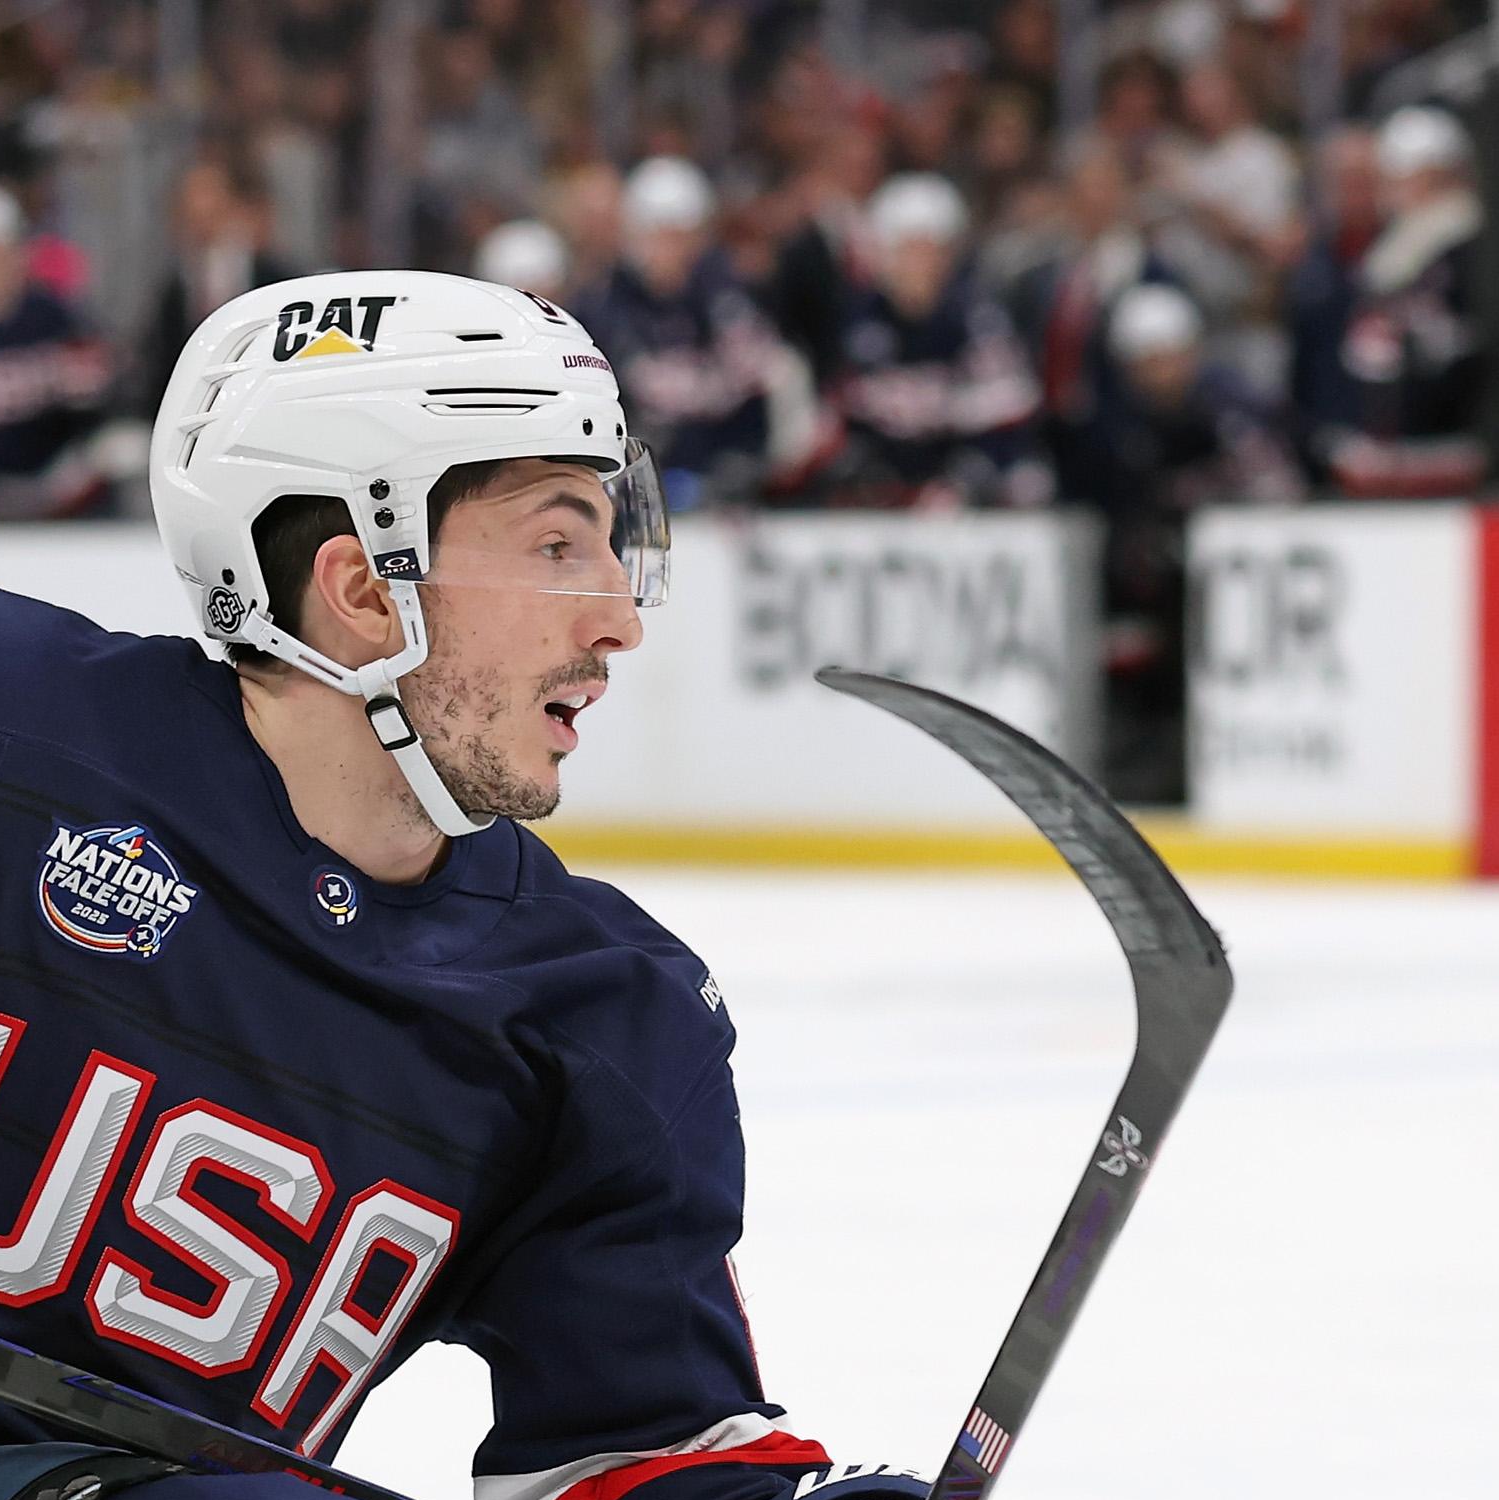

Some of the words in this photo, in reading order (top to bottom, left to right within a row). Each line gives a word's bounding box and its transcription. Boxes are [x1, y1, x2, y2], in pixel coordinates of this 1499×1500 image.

[273, 296, 396, 362] CAT
[45, 827, 197, 914] NATIONS
[47, 862, 171, 926] FACE-OFF
[71, 903, 110, 925] 2025
